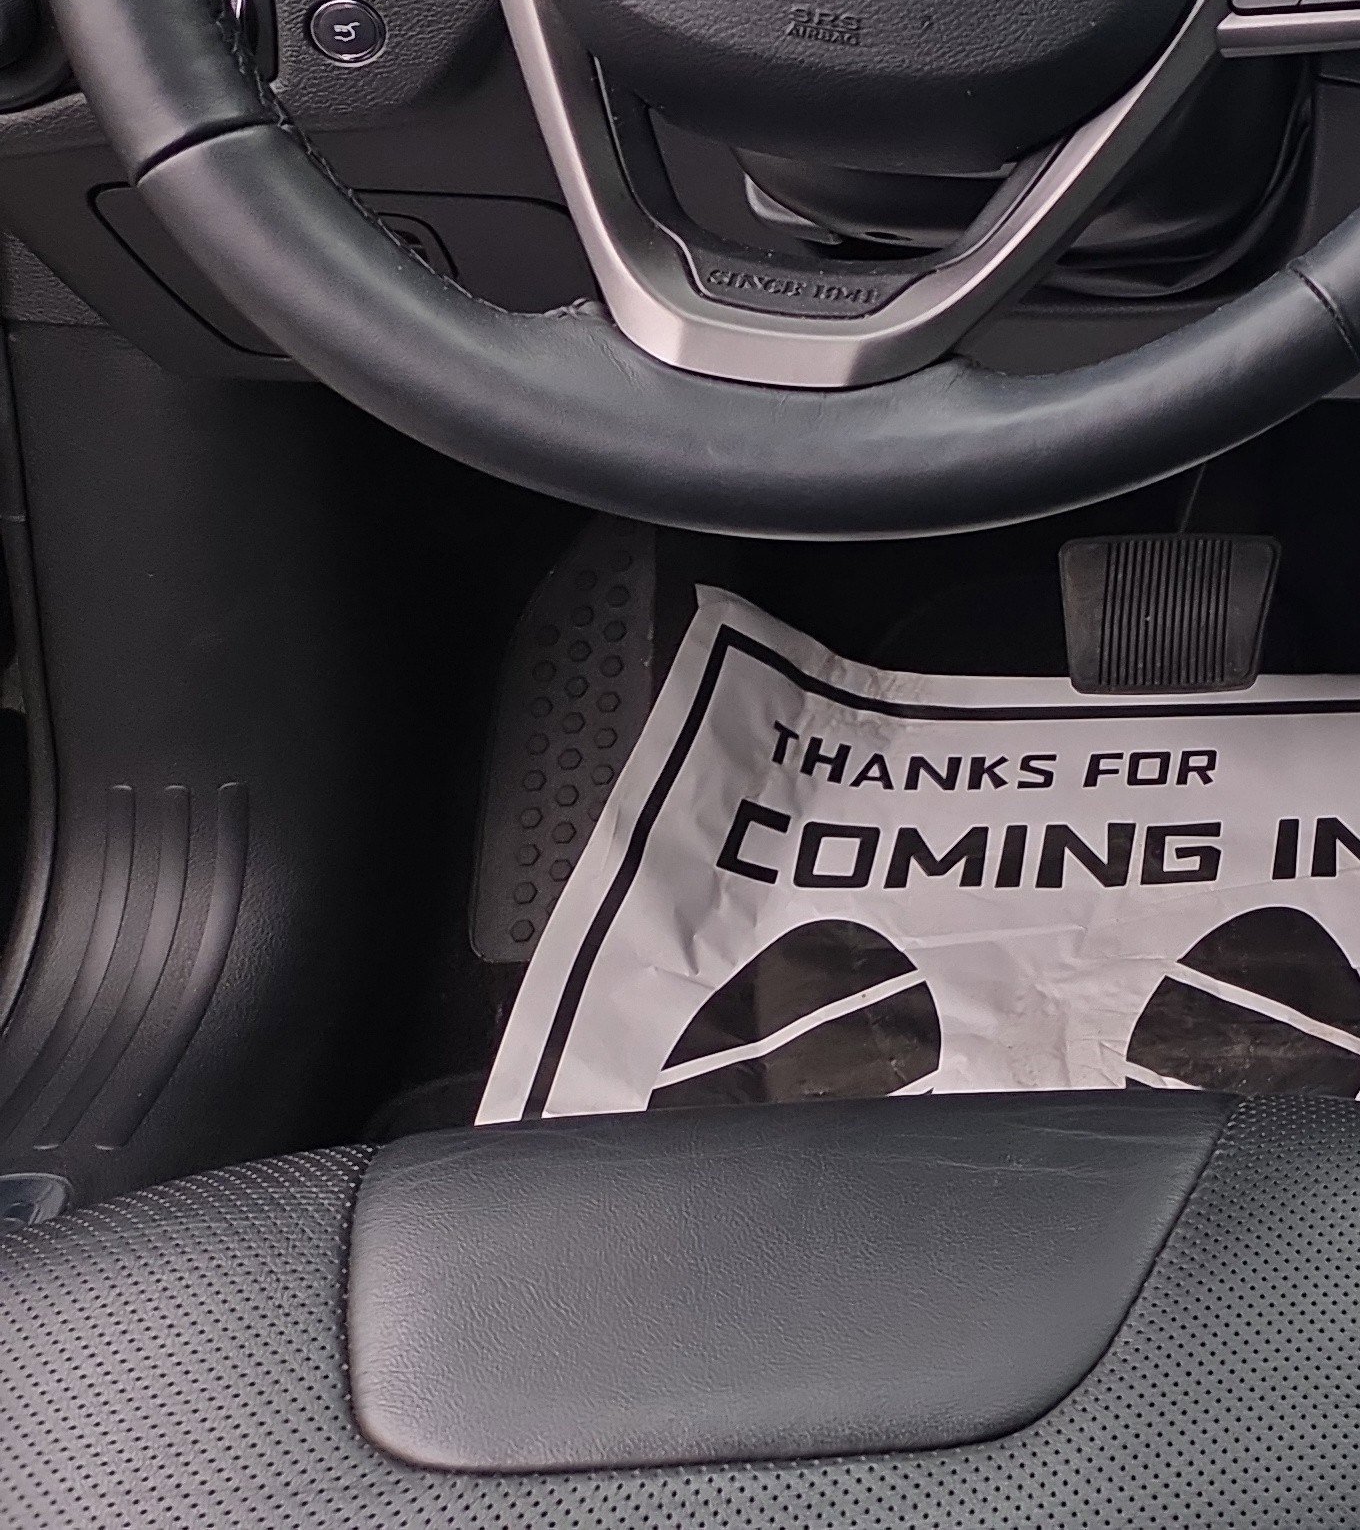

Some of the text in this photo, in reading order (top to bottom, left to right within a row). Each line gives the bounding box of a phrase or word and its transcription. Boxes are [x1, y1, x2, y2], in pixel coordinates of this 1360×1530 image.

[707, 269, 807, 297] SINCE
[771, 722, 1220, 792] THANKS FOR
[715, 797, 1224, 892] COMING
